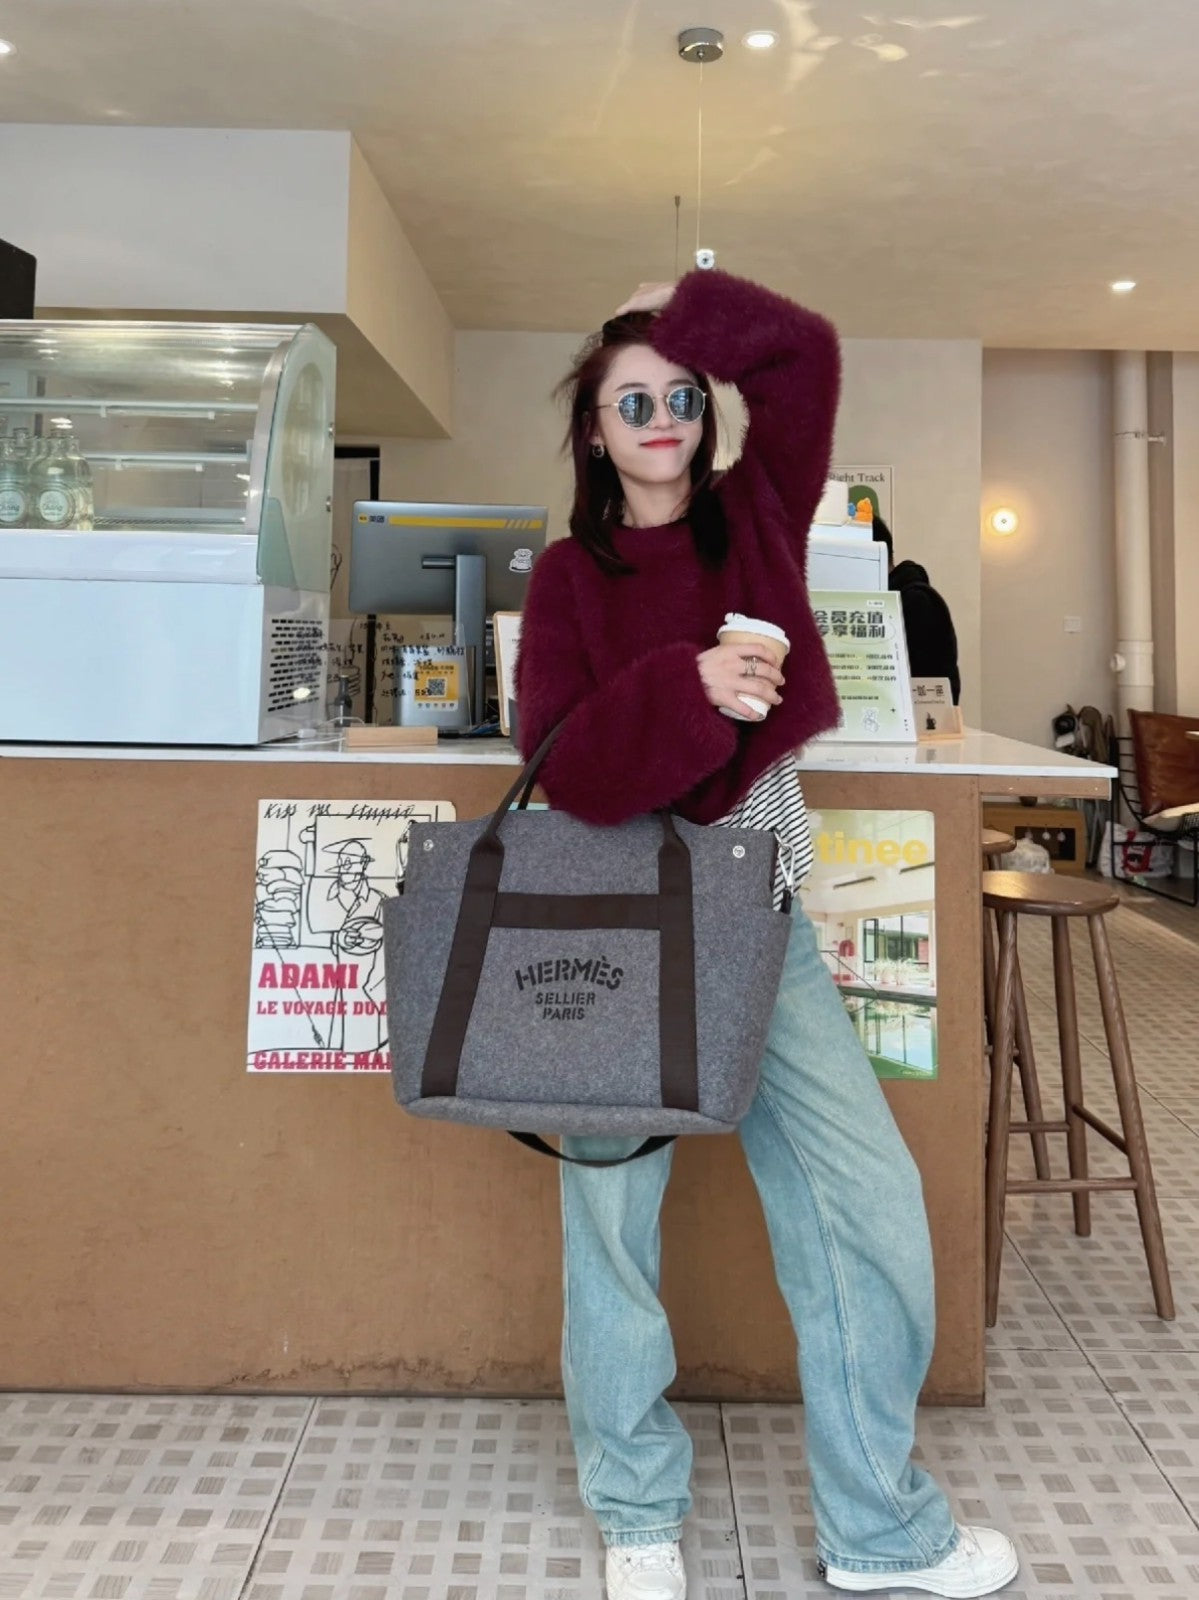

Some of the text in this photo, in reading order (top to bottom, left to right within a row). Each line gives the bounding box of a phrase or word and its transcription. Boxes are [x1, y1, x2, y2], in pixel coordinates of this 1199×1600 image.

[857, 472, 885, 482] Track
[814, 610, 883, 624] 会员充值
[816, 831, 928, 865] tinee
[258, 963, 359, 989] ADAMI
[515, 955, 624, 991] HERMÈS
[535, 992, 596, 1006] SELLIER
[257, 1001, 278, 1015] LE
[282, 1001, 347, 1015] VOYAGE
[353, 1001, 378, 1015] DU
[542, 1007, 585, 1020] PARIS
[254, 1052, 347, 1070] GALERIE
